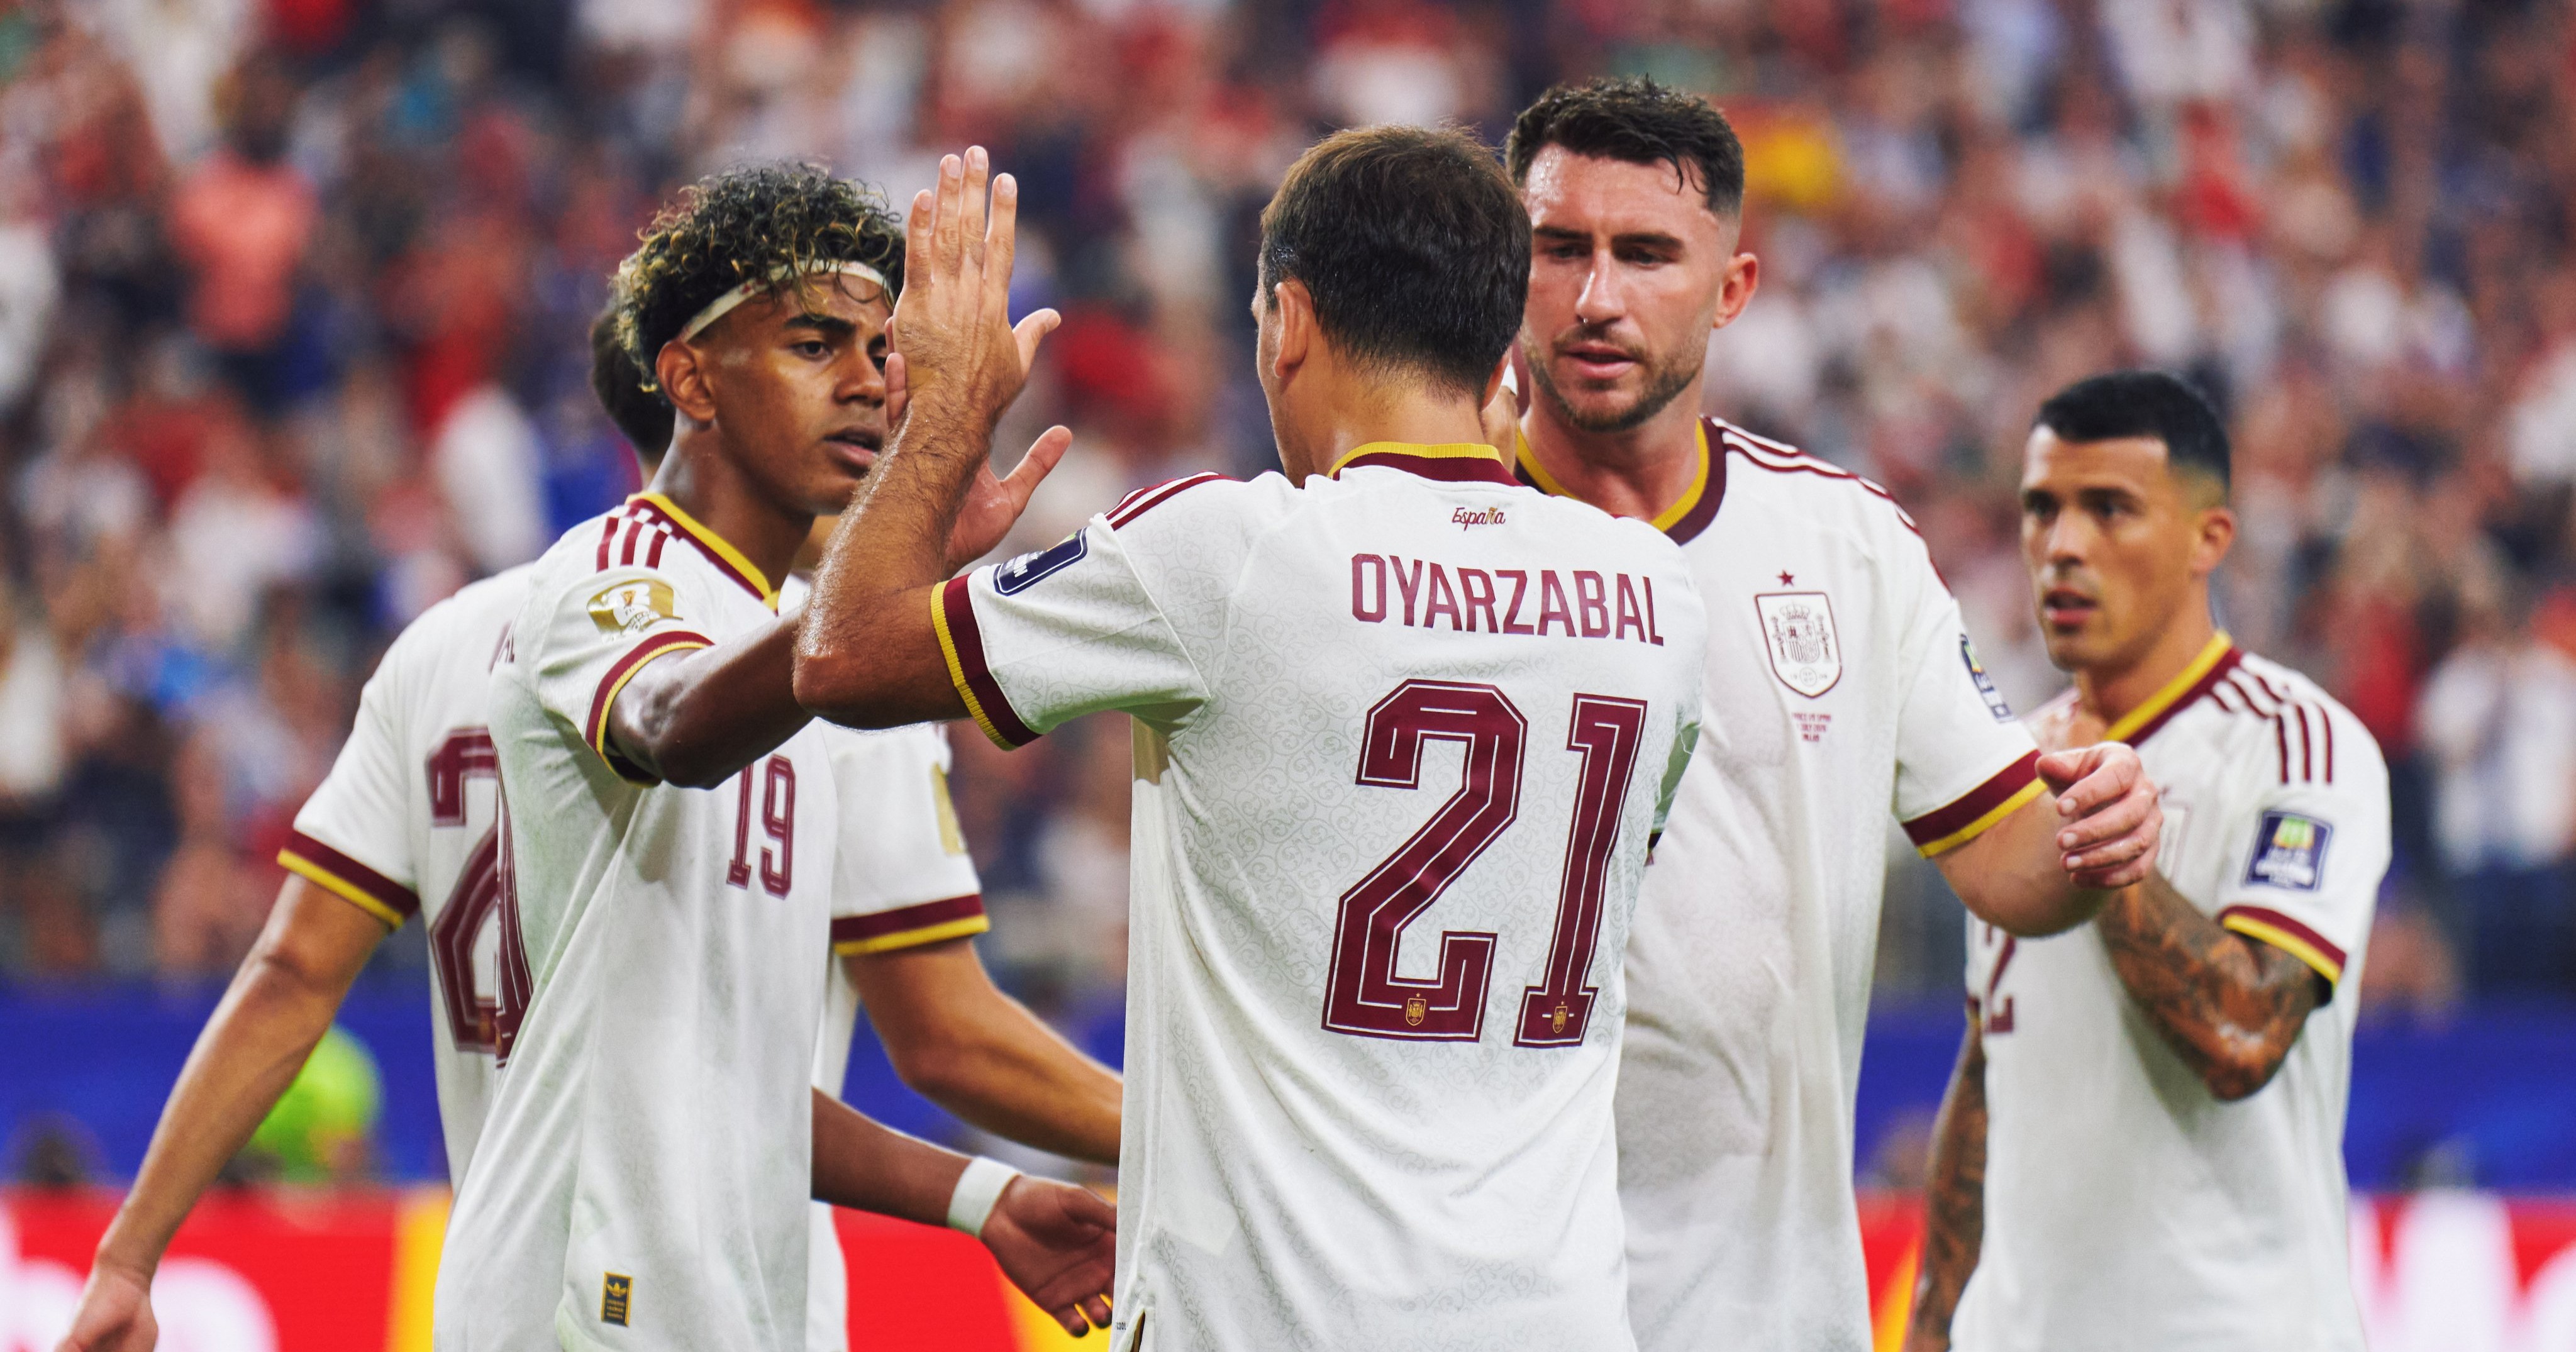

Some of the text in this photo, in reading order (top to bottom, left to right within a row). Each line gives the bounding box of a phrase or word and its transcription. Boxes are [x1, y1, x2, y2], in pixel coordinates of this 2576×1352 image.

[1352, 553, 1664, 646] OYARZABAL
[726, 753, 796, 900] 19
[1321, 679, 1647, 1047] 21
